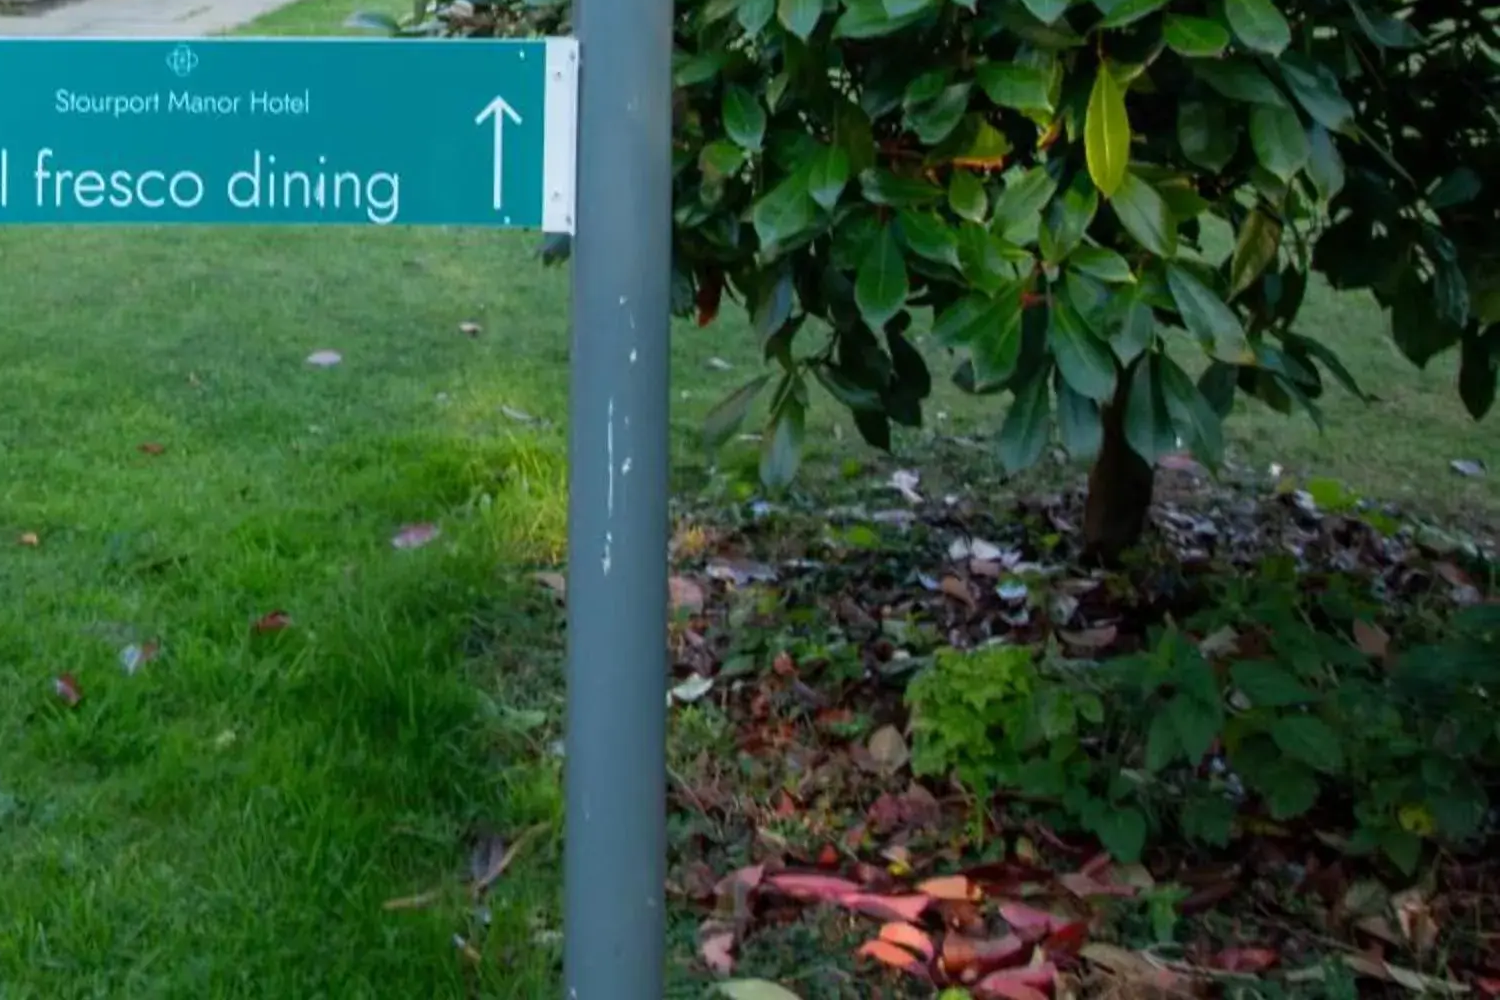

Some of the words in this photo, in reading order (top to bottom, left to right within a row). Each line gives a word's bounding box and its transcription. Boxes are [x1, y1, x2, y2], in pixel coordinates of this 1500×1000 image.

[55, 89, 160, 117] Stourport
[168, 90, 238, 114] Manor
[250, 89, 310, 114] Hotel
[35, 149, 204, 207] fresco
[227, 151, 401, 223] dining
